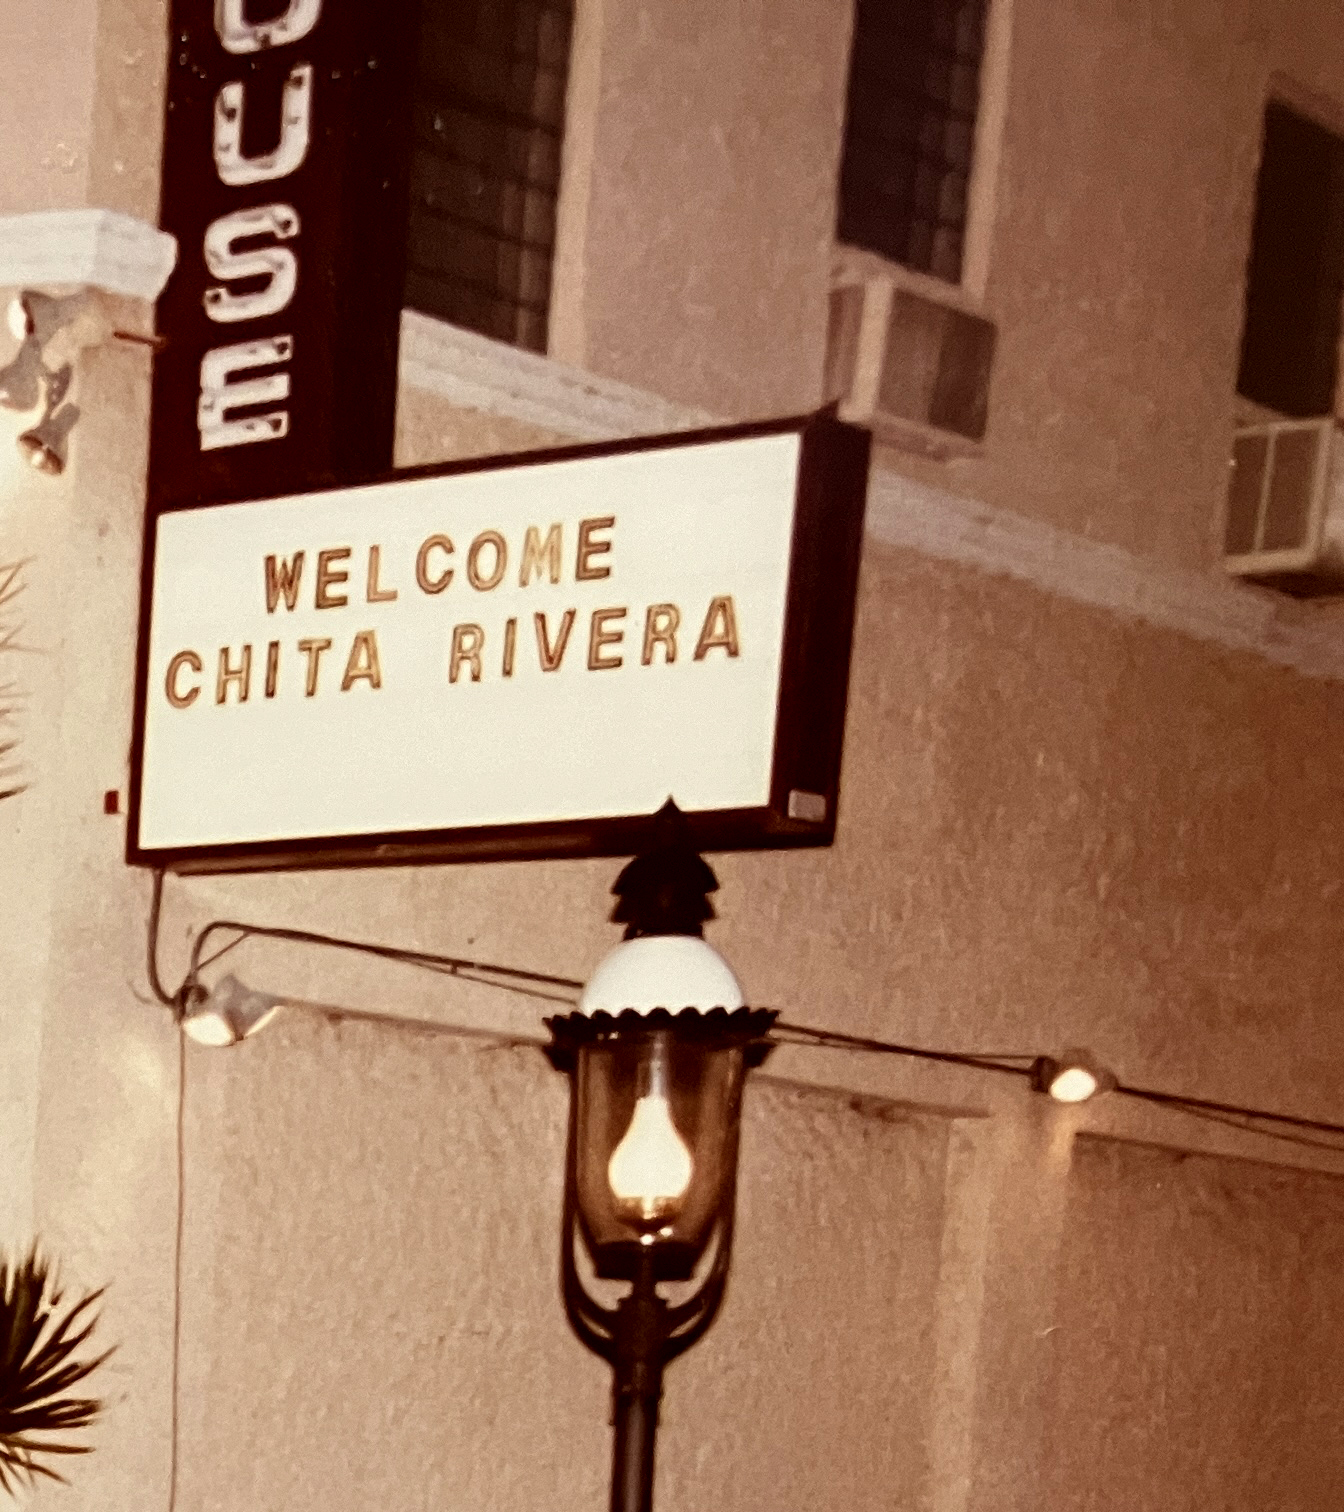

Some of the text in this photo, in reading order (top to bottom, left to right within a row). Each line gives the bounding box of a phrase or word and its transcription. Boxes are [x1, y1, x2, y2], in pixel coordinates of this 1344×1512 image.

[263, 515, 616, 614] WELCOME
[164, 594, 740, 709] CHITA RIVERA
